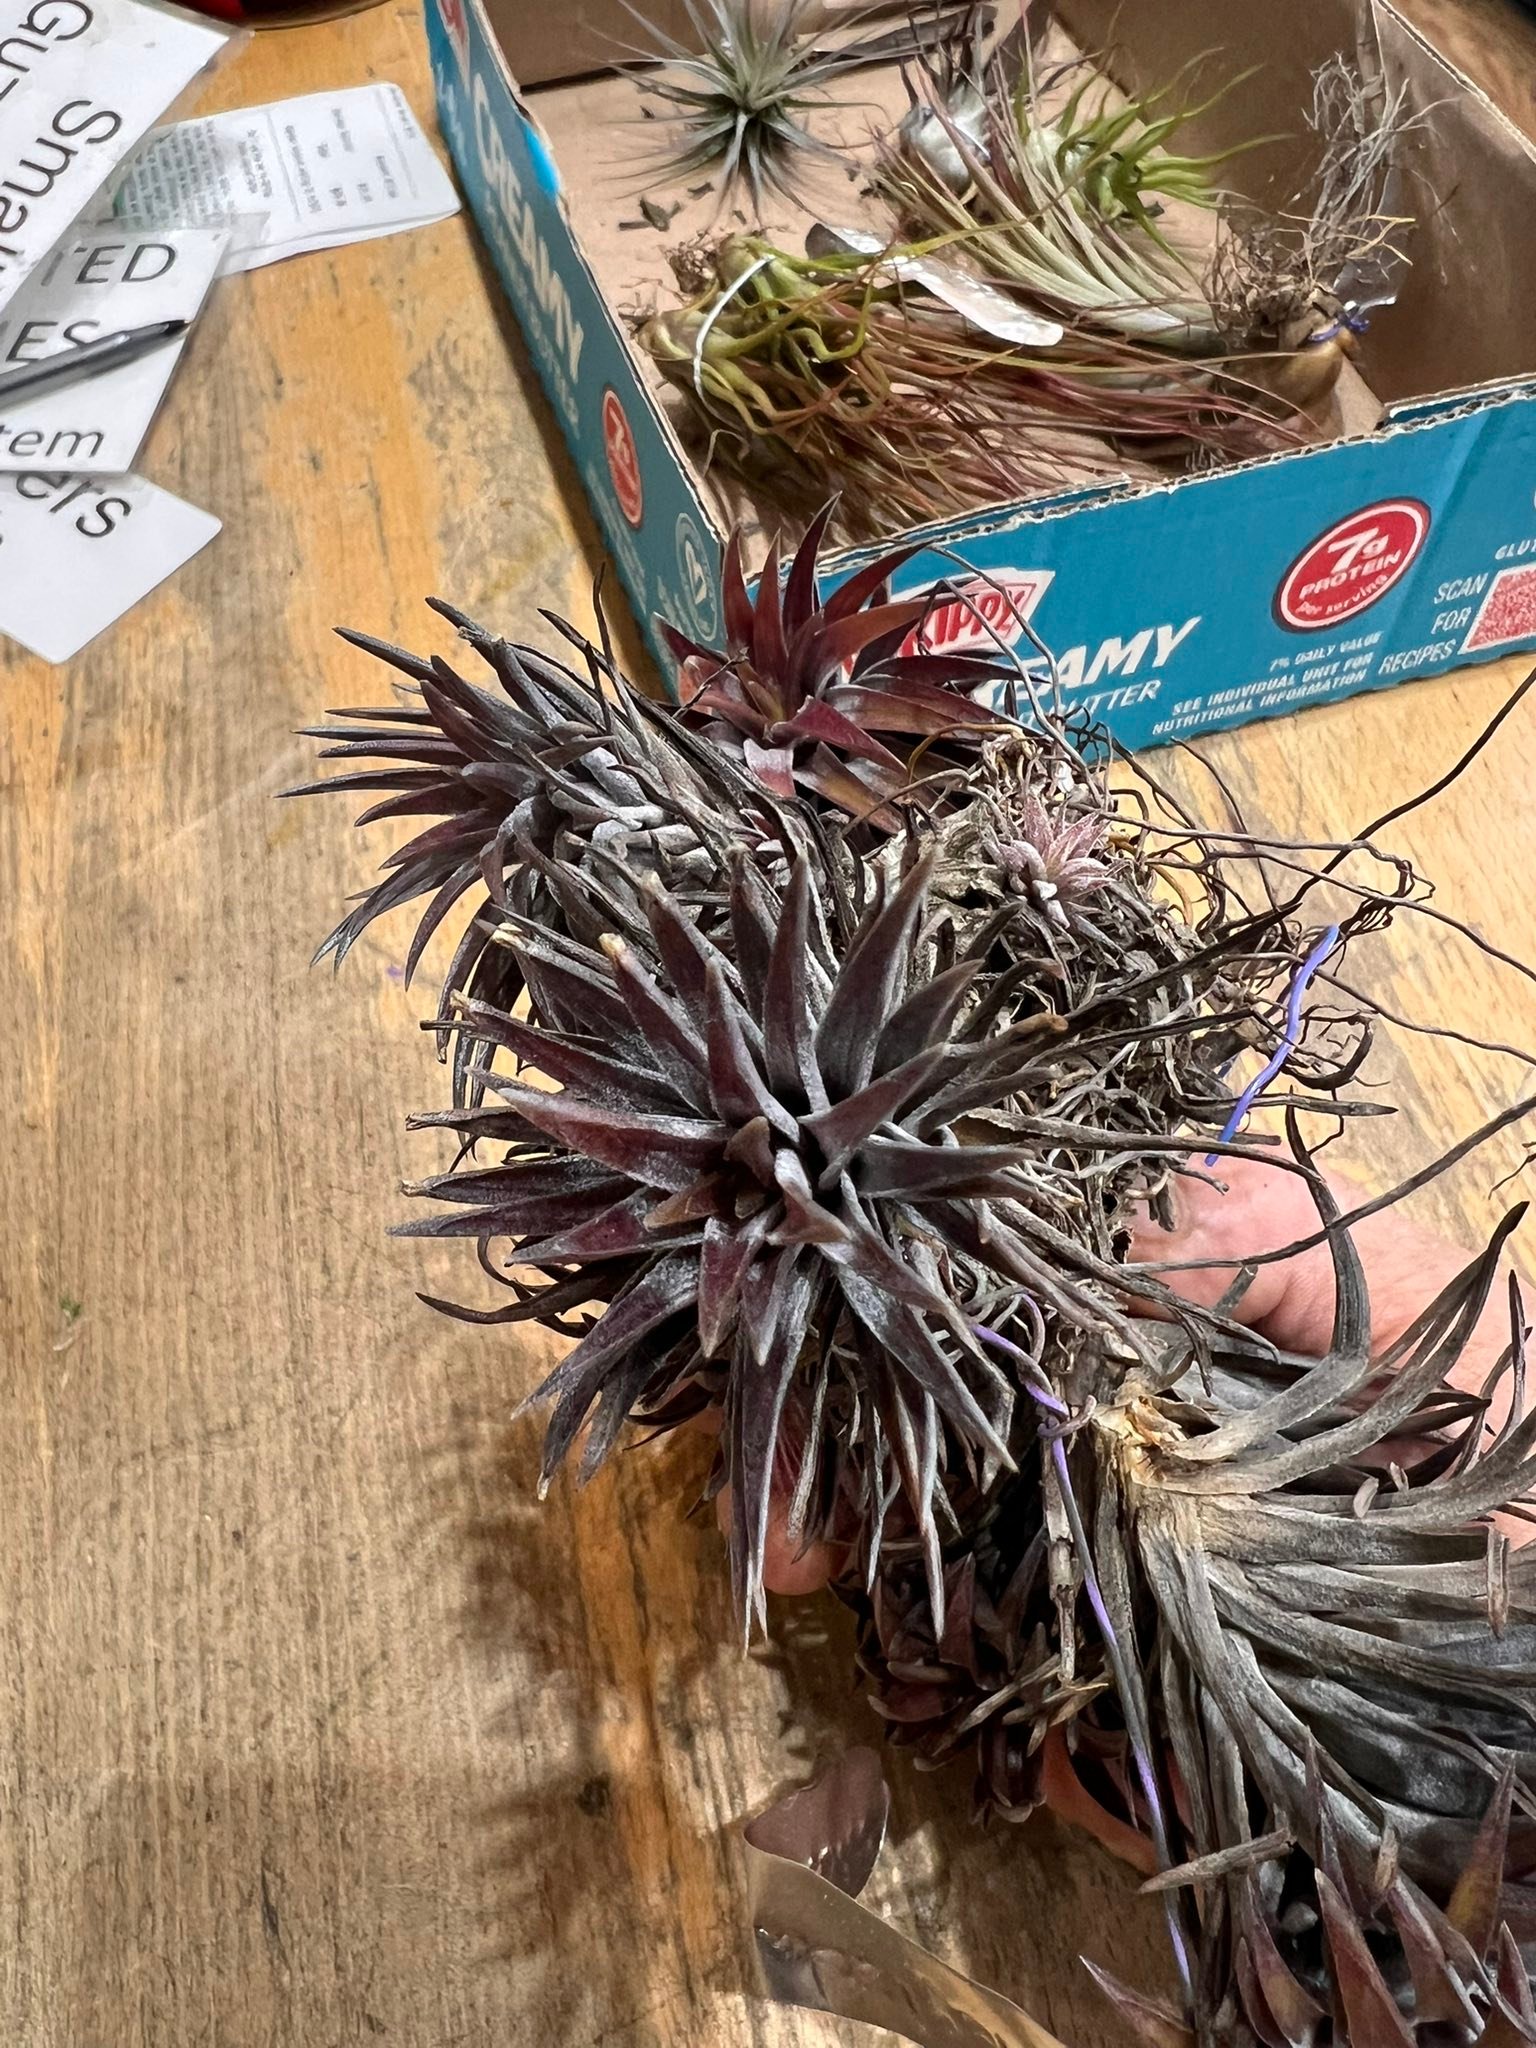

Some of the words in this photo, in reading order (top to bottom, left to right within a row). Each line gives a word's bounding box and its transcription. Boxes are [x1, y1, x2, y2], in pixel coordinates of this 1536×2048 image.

[1327, 527, 1389, 576] 7g
[1299, 549, 1402, 600] PROTEIN
[1325, 573, 1390, 616] serving
[1434, 572, 1489, 604] SCAN
[1431, 607, 1471, 635] FOR
[1295, 644, 1336, 665] DAILY
[1339, 631, 1383, 653] VALUE
[1378, 639, 1456, 676] RECIPES
[1152, 702, 1253, 736] NUTRITIONAL
[1259, 668, 1367, 707] INFORMATION
[1172, 696, 1202, 716] SEE
[1207, 674, 1296, 707] INDIVIDUAL
[1302, 661, 1341, 683] UNIT
[1343, 652, 1374, 672] FOR
